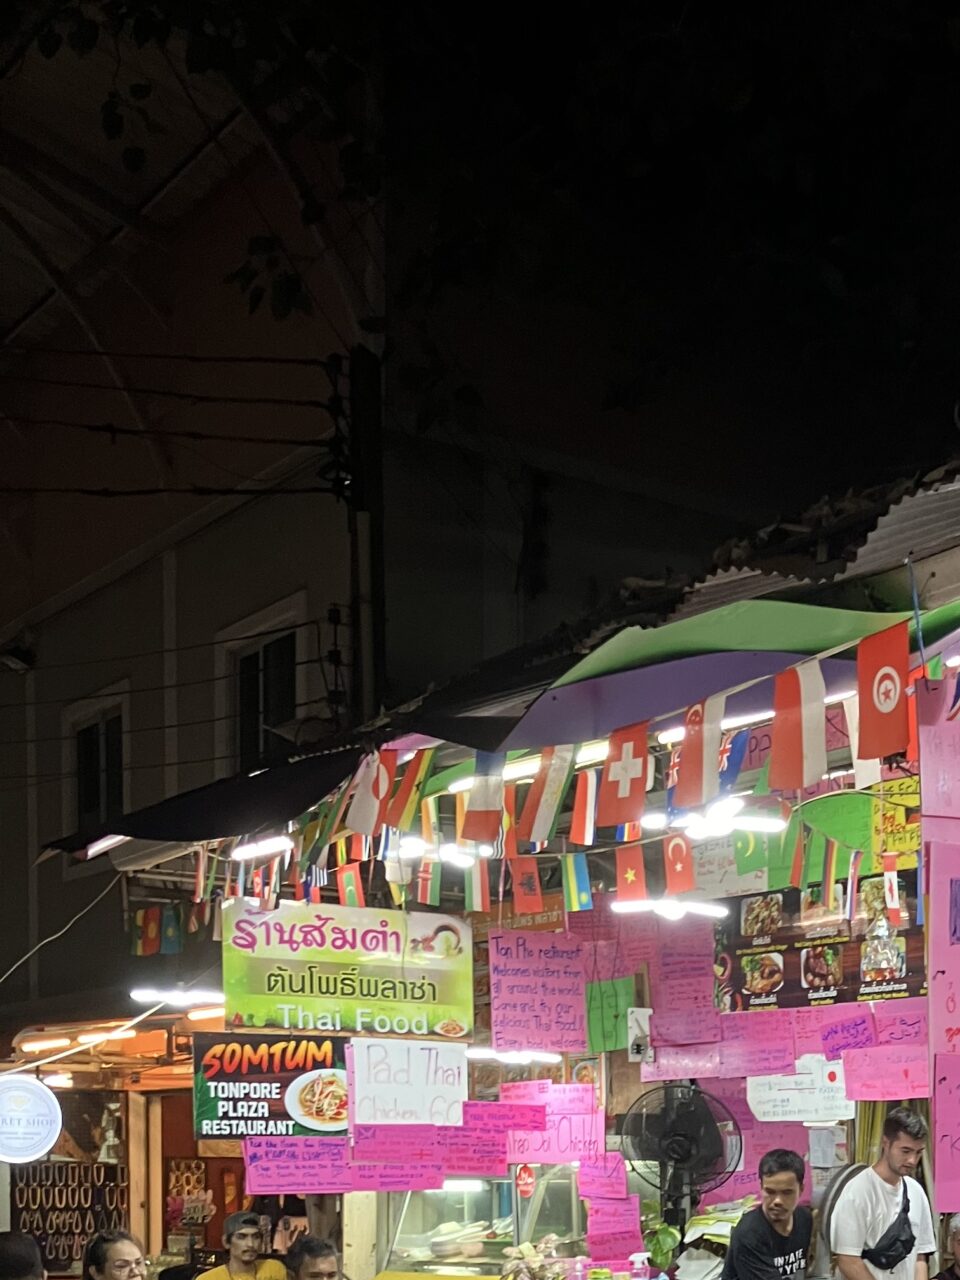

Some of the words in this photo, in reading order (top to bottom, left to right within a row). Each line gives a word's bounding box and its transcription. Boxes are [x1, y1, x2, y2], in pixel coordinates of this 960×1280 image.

[231, 907, 402, 955] ร้านส้มตำ
[266, 964, 438, 1003] ต้นโพธิ์พลาซ่า
[276, 1003, 342, 1032] Thai
[355, 1007, 430, 1036] Food
[201, 1040, 334, 1079] SOMTUM
[365, 1043, 412, 1087] Pad
[420, 1045, 462, 1088] Thai
[206, 1081, 282, 1099] TONPORE
[217, 1101, 269, 1118] PLAZA
[427, 1095, 463, 1126] 60
[201, 1119, 296, 1137] RESTAURANT
